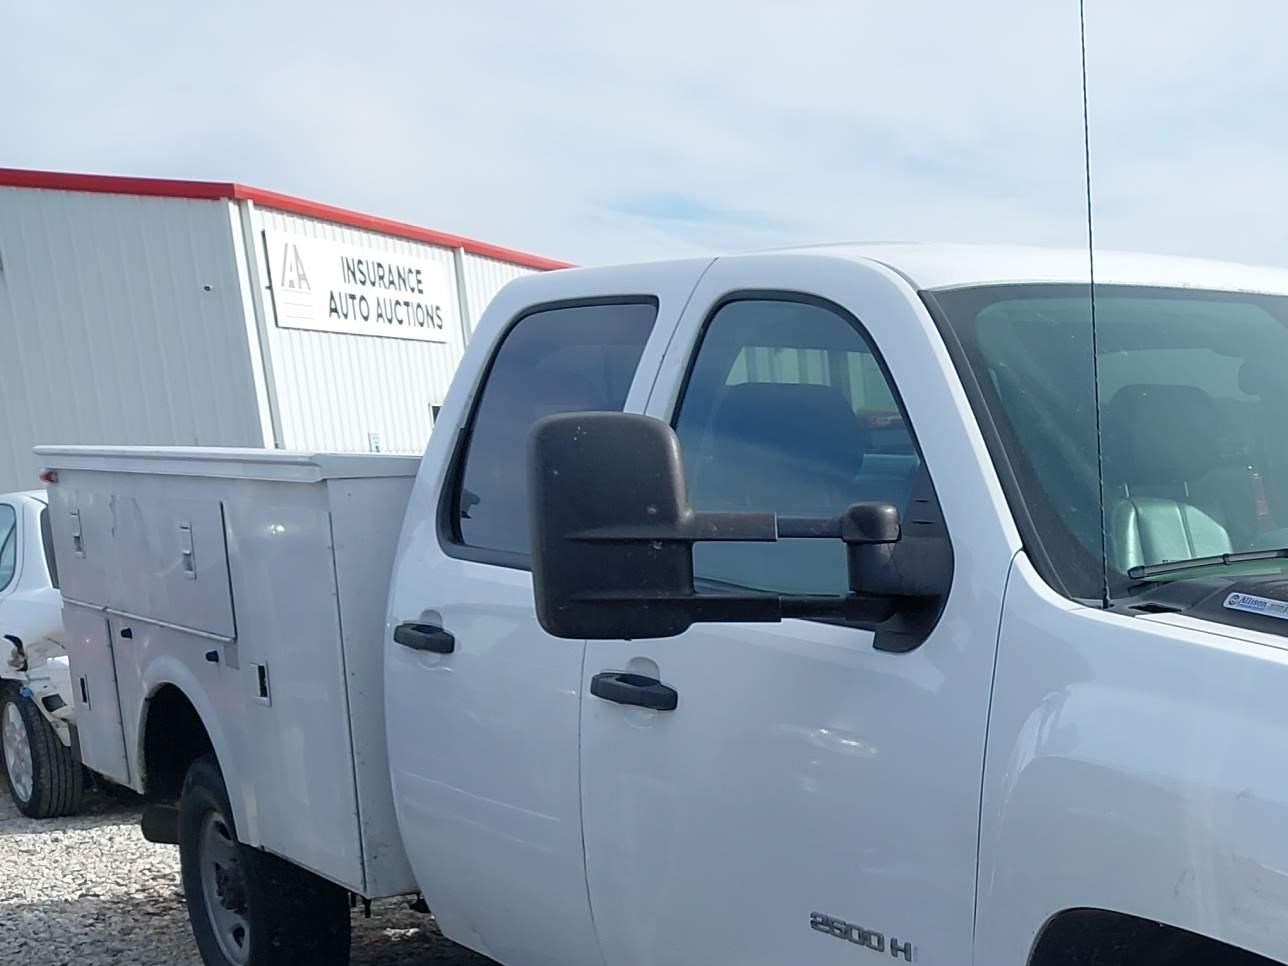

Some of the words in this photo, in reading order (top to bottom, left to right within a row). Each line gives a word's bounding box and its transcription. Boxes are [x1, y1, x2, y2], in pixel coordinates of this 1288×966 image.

[341, 255, 424, 294] INSURANCE
[328, 290, 370, 322] AUTO
[376, 296, 443, 330] AUCTIONS
[810, 911, 885, 953] 2500
[890, 937, 912, 962] H
